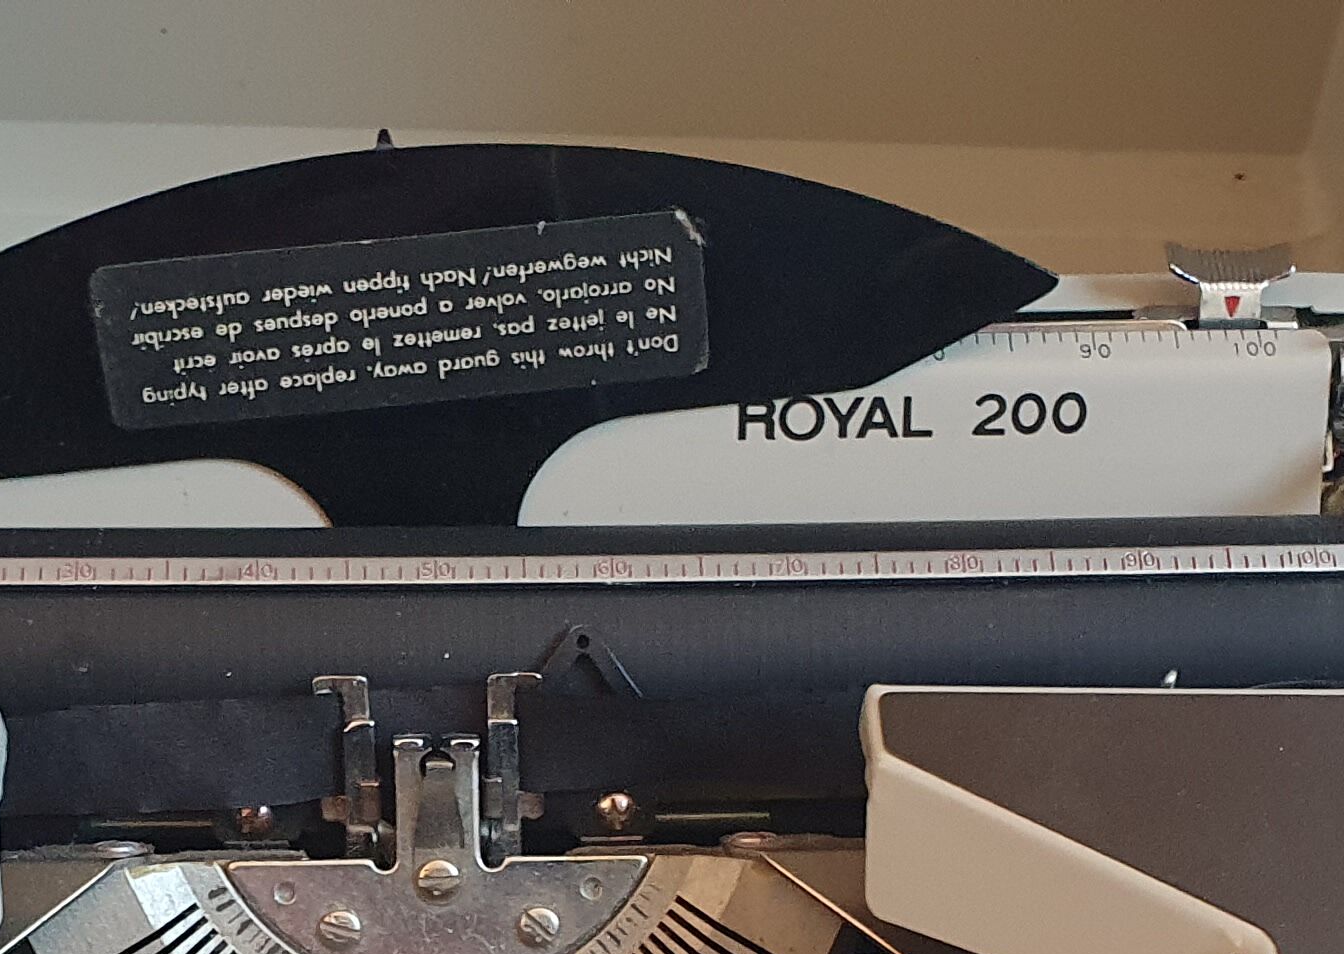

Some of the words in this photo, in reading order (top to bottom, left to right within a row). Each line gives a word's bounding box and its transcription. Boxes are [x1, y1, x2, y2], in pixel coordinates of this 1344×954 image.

[619, 247, 672, 270] Nicht
[421, 268, 476, 292] Nach
[483, 253, 606, 286] wegwerfen!
[343, 270, 409, 294] tippen
[644, 277, 675, 295] No
[130, 291, 250, 320] aufstecken!
[262, 284, 332, 307] wieder
[466, 293, 527, 313] volver
[349, 298, 427, 328] ponerlo
[440, 300, 453, 313] a
[646, 305, 676, 323] Ne
[254, 309, 338, 332] despues
[547, 308, 605, 331] jettez
[616, 310, 634, 329] le
[132, 326, 204, 351] escribir
[216, 322, 242, 342] de
[393, 326, 482, 348] remettez
[362, 337, 381, 356] le
[558, 341, 614, 363] throw
[627, 334, 678, 358] Don't
[1080, 343, 1111, 358] 90
[1234, 342, 1276, 357] 100
[229, 348, 280, 369] avoir
[439, 349, 500, 379] guard
[512, 349, 546, 370] this
[219, 378, 268, 399] after
[279, 366, 356, 392] replace
[142, 381, 206, 407] typing
[738, 395, 933, 441] ROYAL
[971, 392, 1088, 436] 200
[243, 562, 274, 578] 40
[421, 561, 452, 577] 50
[597, 559, 629, 576] 60
[1125, 552, 1156, 567] 90
[61, 562, 93, 579] 30
